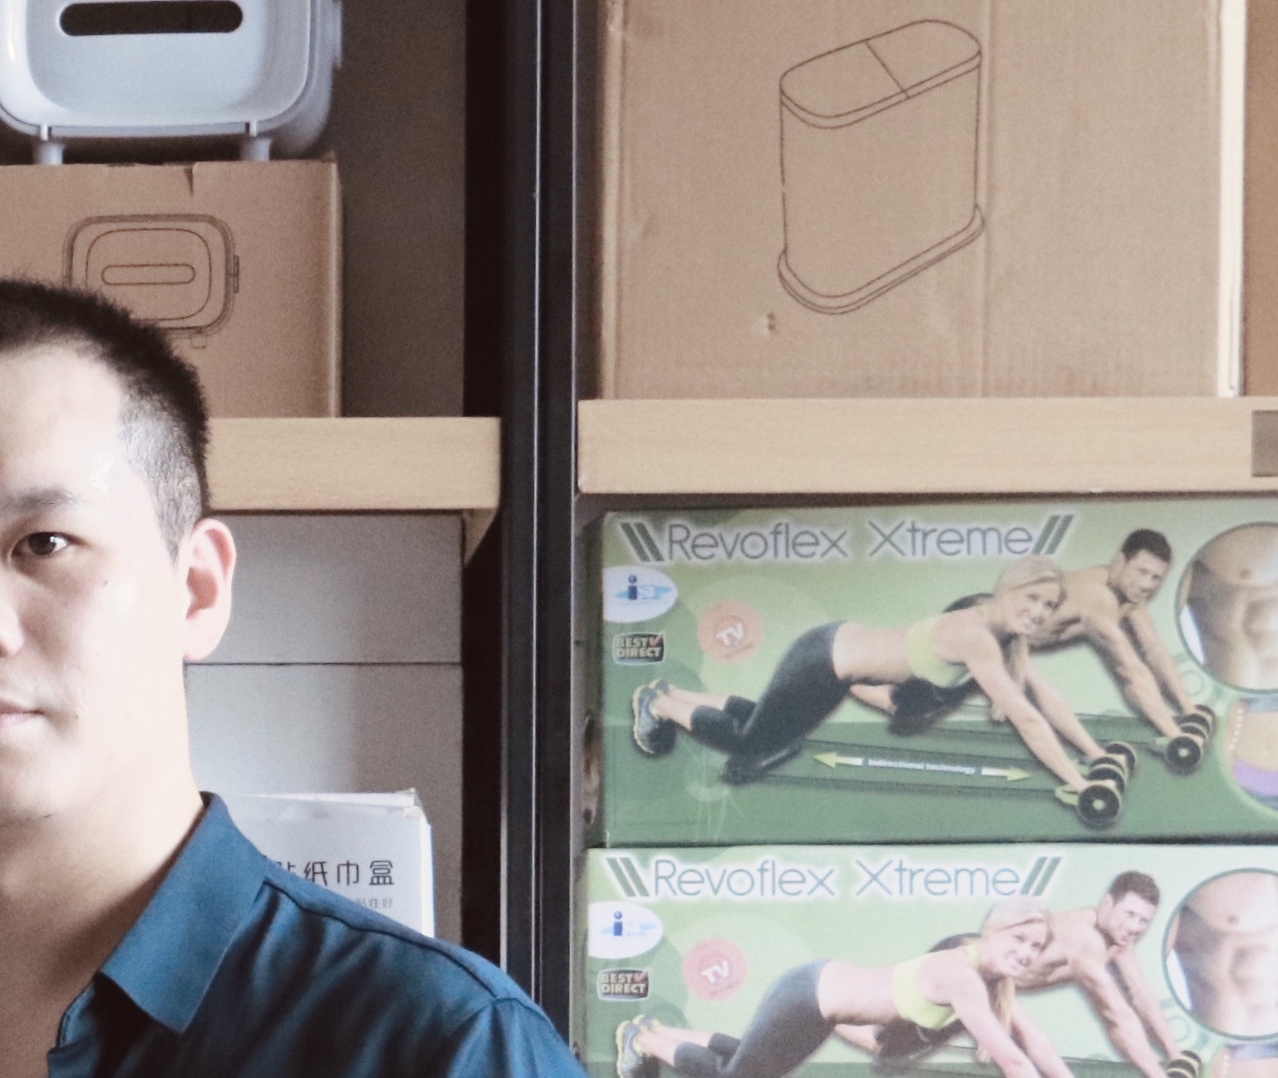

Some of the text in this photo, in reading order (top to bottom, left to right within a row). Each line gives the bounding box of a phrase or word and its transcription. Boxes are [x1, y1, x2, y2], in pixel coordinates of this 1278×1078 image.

[668, 519, 1033, 561] Revoflex Xtreme
[616, 637, 649, 648] BEST
[716, 623, 744, 646] TV
[616, 647, 661, 658] DIRECT
[655, 858, 1020, 897] Revoflex Xtreme
[600, 973, 633, 983] BEST
[701, 960, 730, 984] TV
[600, 983, 646, 994] DIRECT
